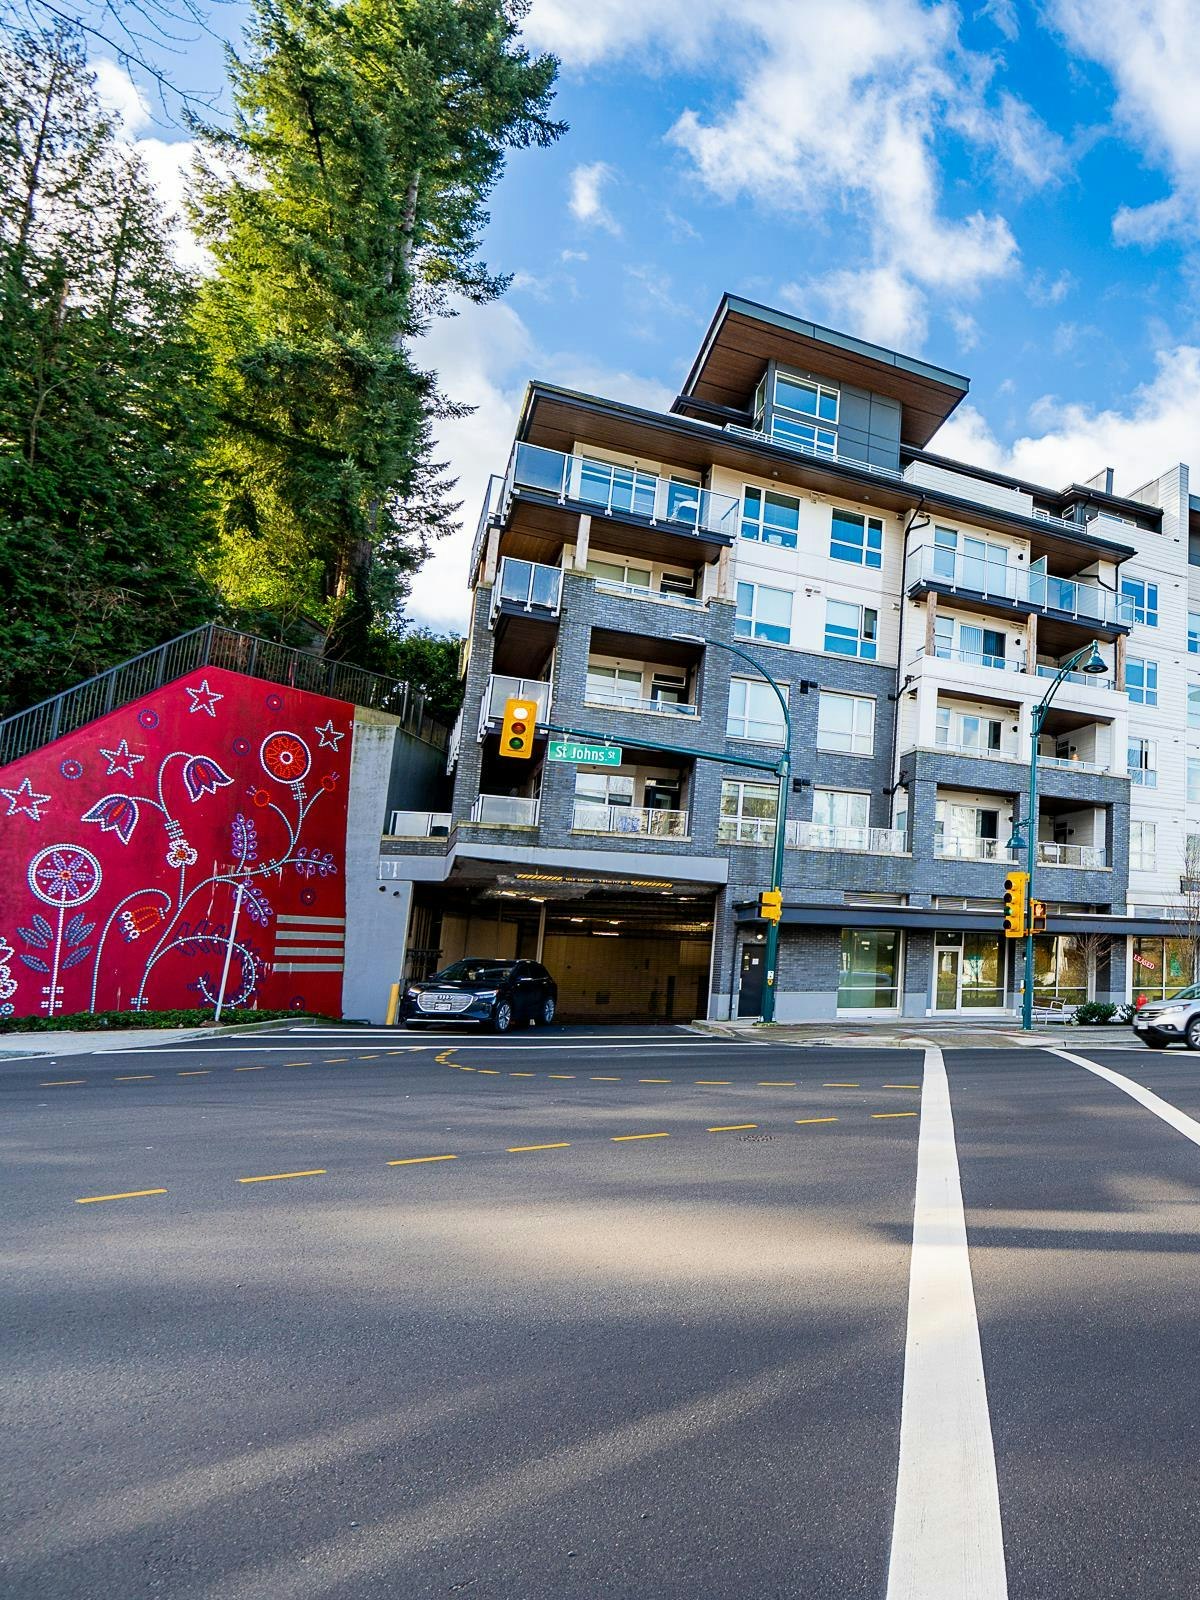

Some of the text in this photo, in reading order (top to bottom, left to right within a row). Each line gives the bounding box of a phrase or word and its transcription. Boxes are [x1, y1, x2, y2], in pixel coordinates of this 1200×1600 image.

[556, 746, 615, 761] St Johns St
[1133, 954, 1155, 969] LEASED
